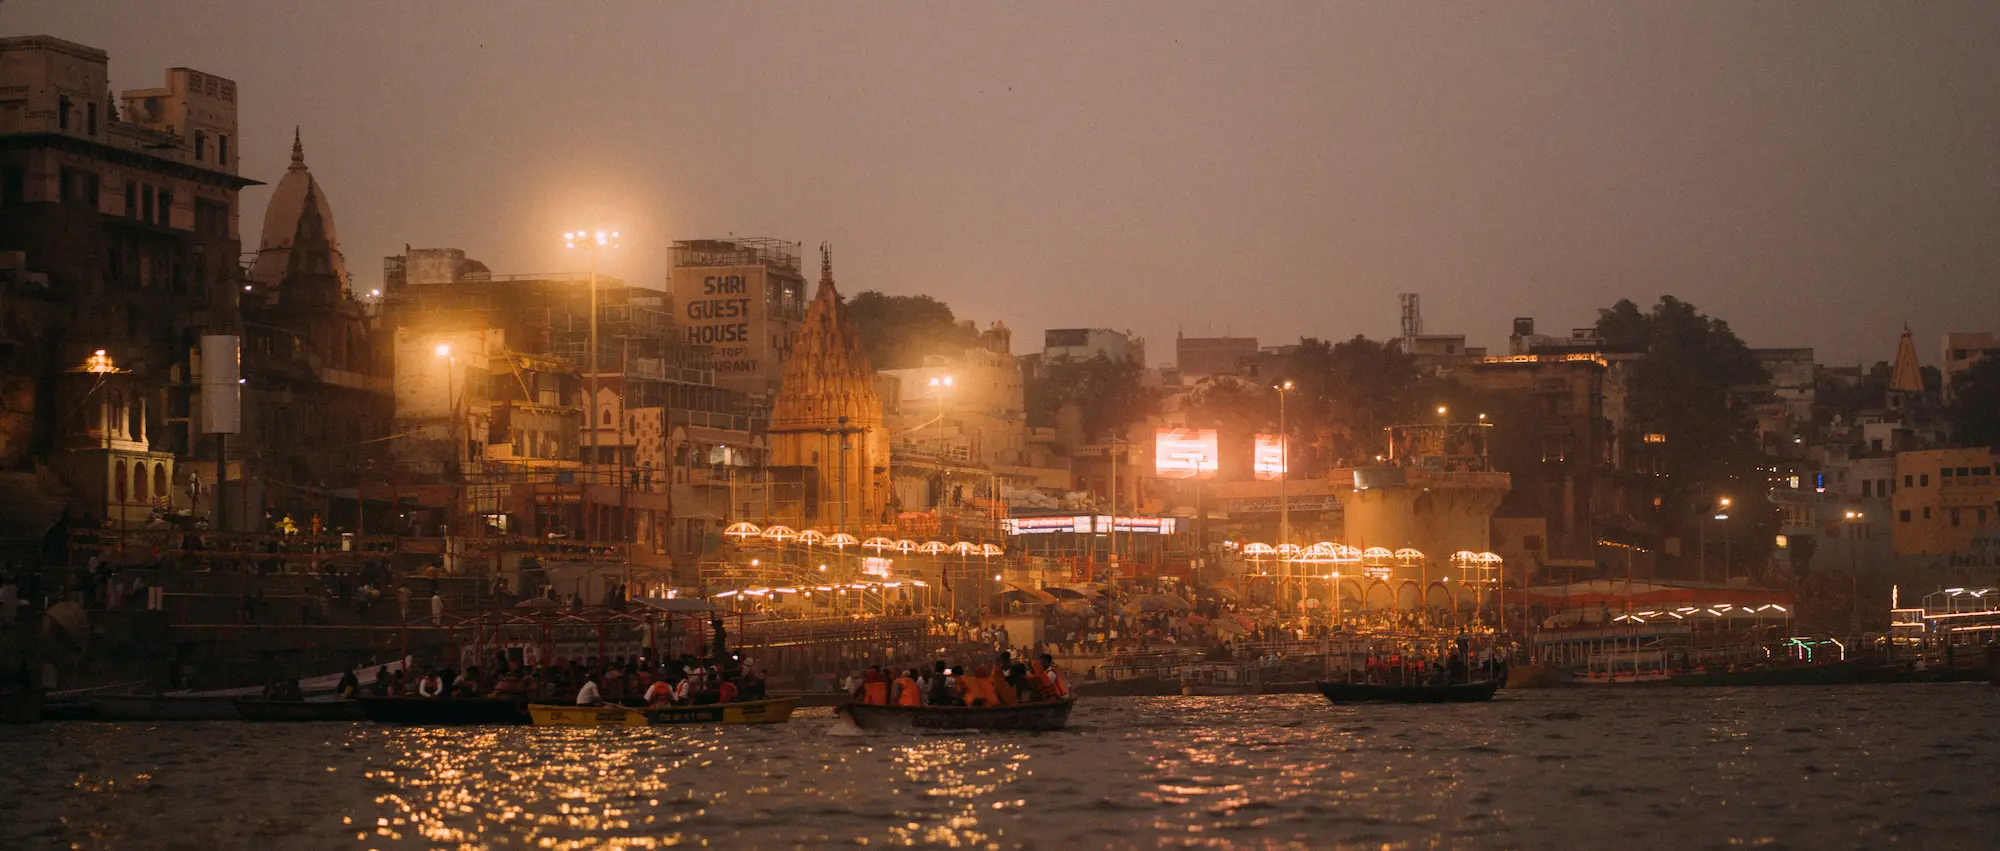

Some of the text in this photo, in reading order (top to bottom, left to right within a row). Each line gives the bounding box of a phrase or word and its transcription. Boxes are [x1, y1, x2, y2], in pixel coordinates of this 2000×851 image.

[704, 275, 746, 295] SHRI
[687, 298, 751, 319] GUEST
[688, 323, 748, 344] HOUSE
